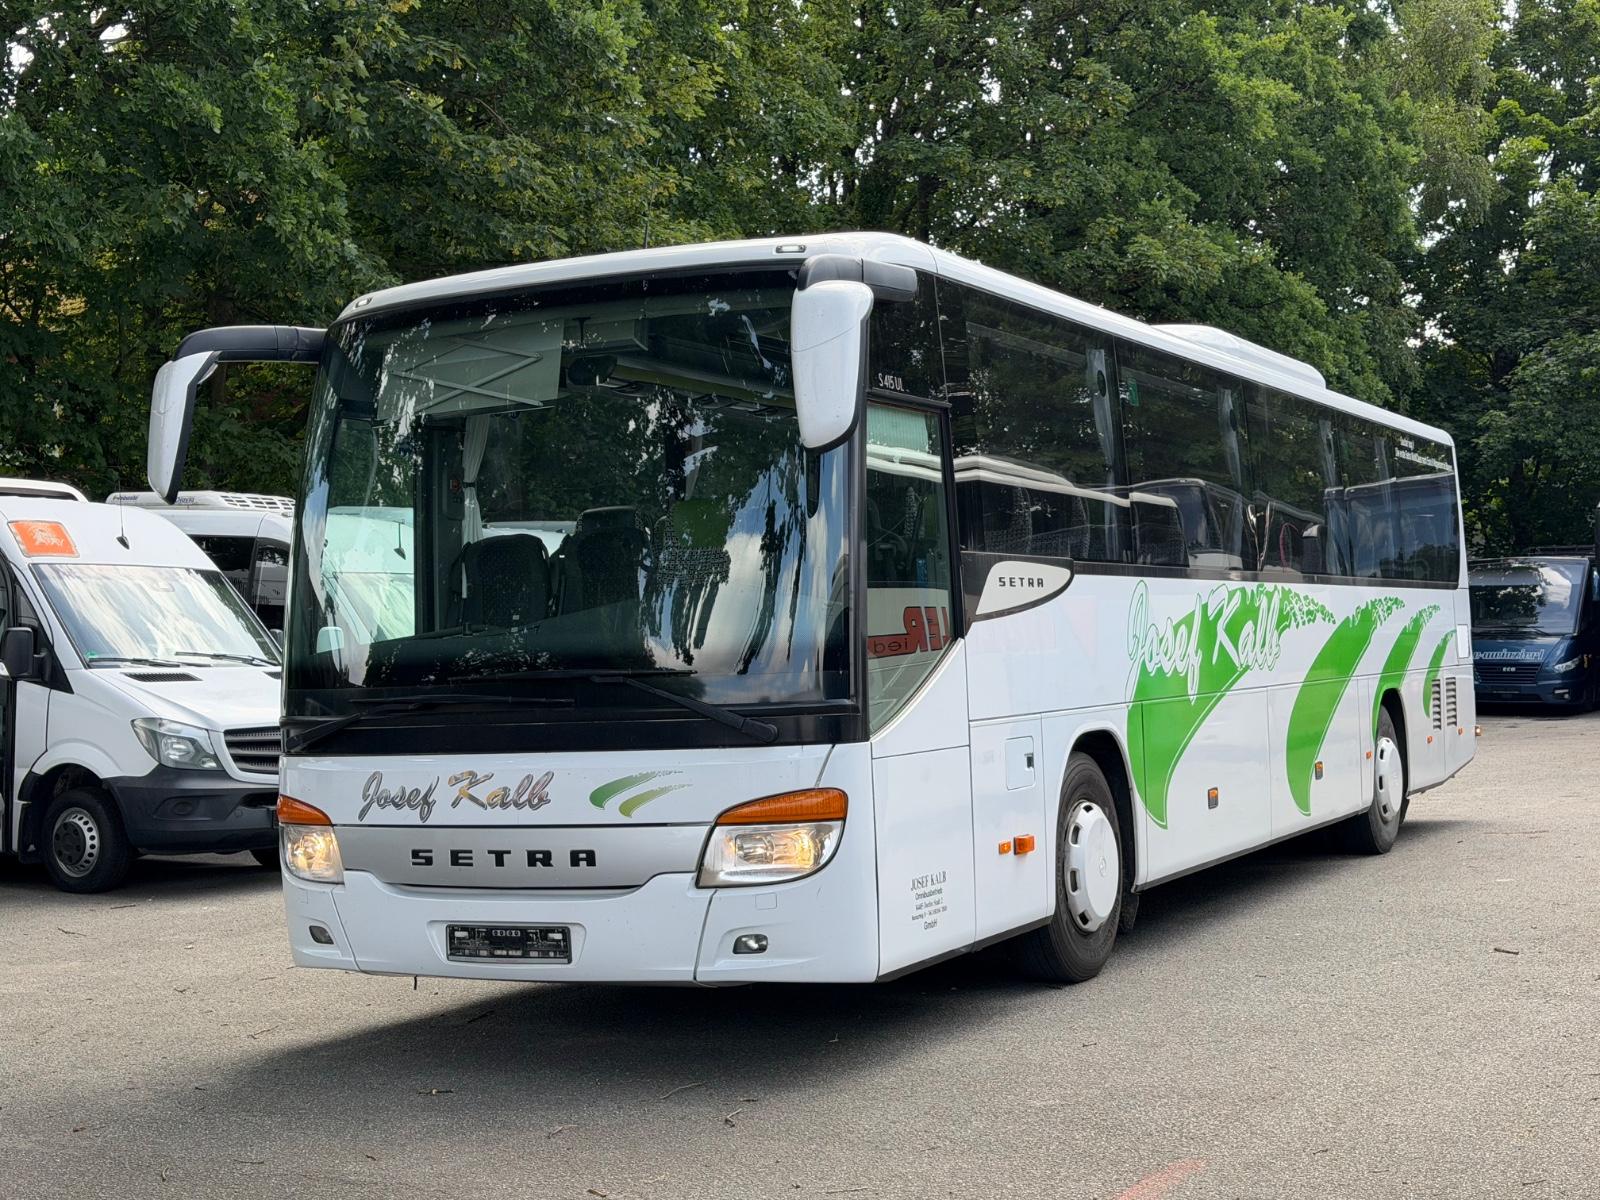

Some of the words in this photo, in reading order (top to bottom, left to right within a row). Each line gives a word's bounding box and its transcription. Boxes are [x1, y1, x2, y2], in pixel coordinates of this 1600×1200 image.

[878, 372, 884, 387] S
[894, 376, 904, 391] UL
[998, 576, 1044, 588] SETRA
[1125, 579, 1202, 709] Josef
[1208, 583, 1282, 672] Kalb
[357, 770, 440, 824] Josef
[447, 769, 555, 812] Kalb
[411, 848, 597, 868] SETRA
[911, 874, 929, 891] JOSEF
[930, 871, 946, 886] KALB
[923, 918, 938, 930] GmbH
